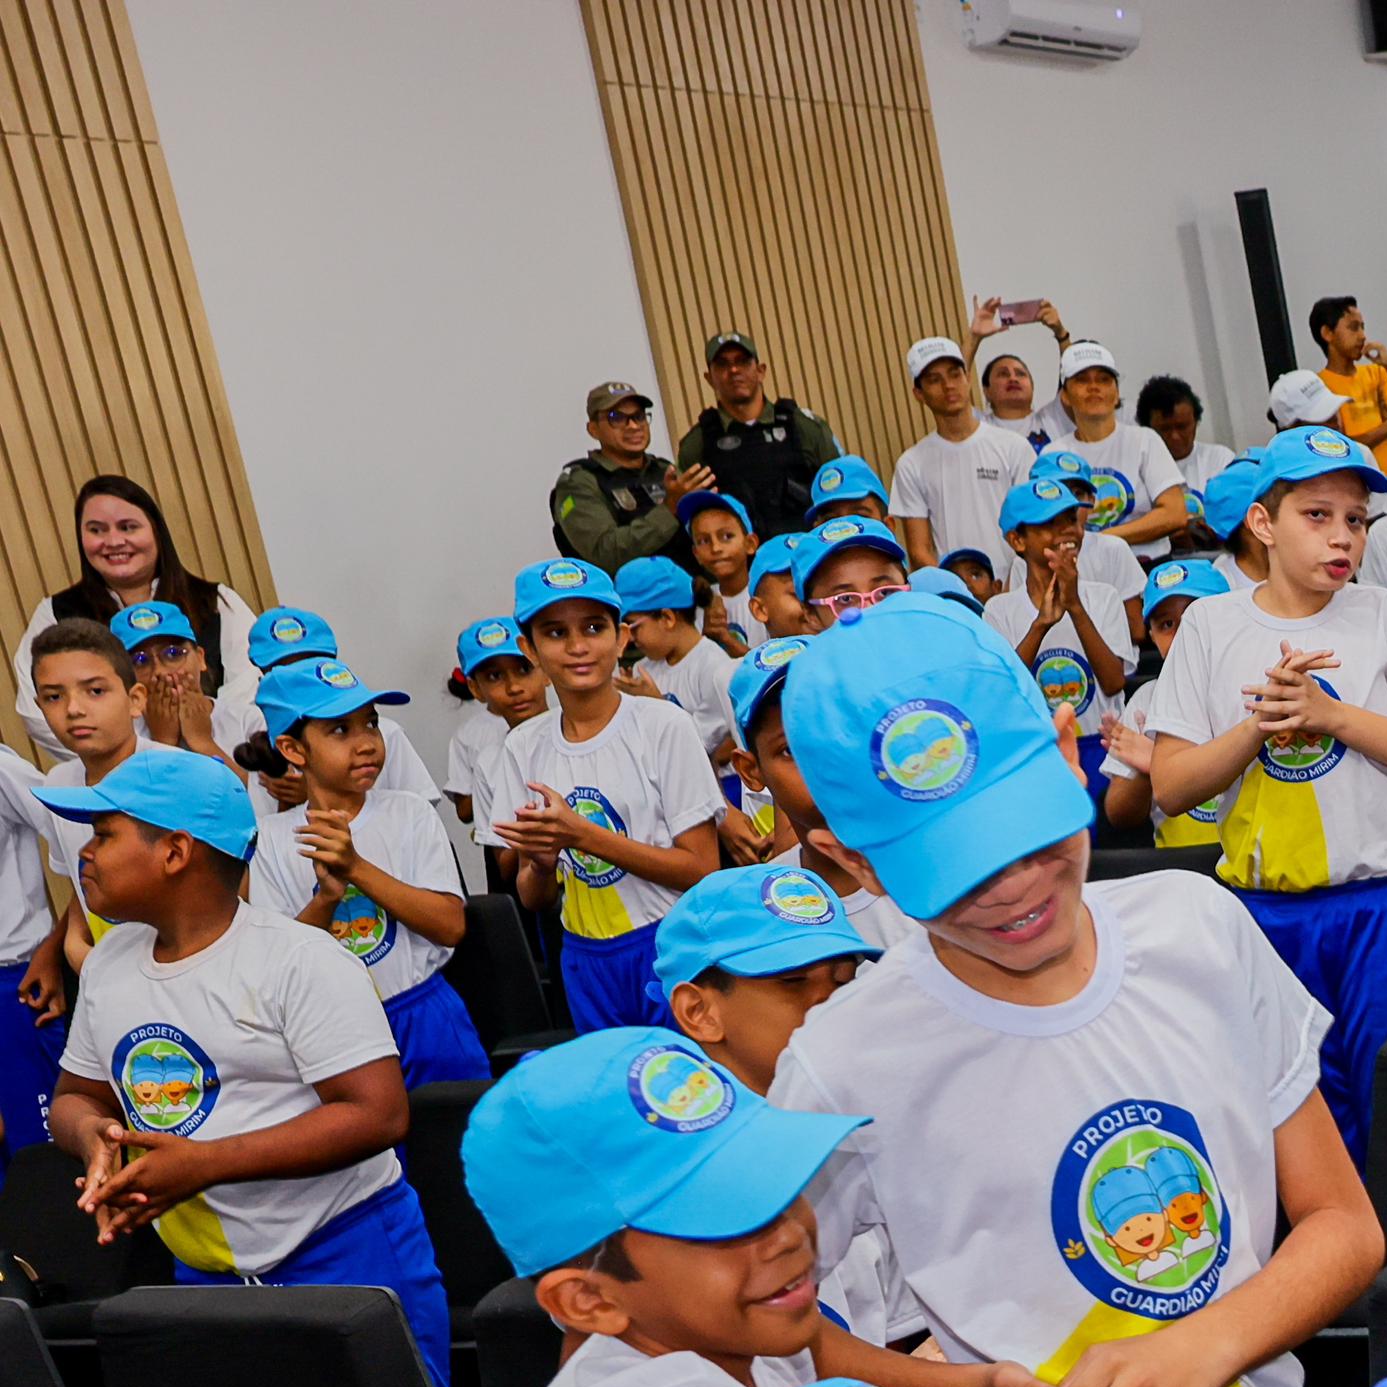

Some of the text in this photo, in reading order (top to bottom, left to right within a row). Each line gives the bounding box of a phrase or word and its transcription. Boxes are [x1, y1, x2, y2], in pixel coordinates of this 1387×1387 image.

[876, 700, 927, 733] PROJETO
[1309, 753, 1339, 778] MIRIM
[130, 1025, 183, 1043] PROJETO
[175, 1108, 206, 1137] MIRIM
[1110, 1285, 1203, 1317] GUARDIÃO
